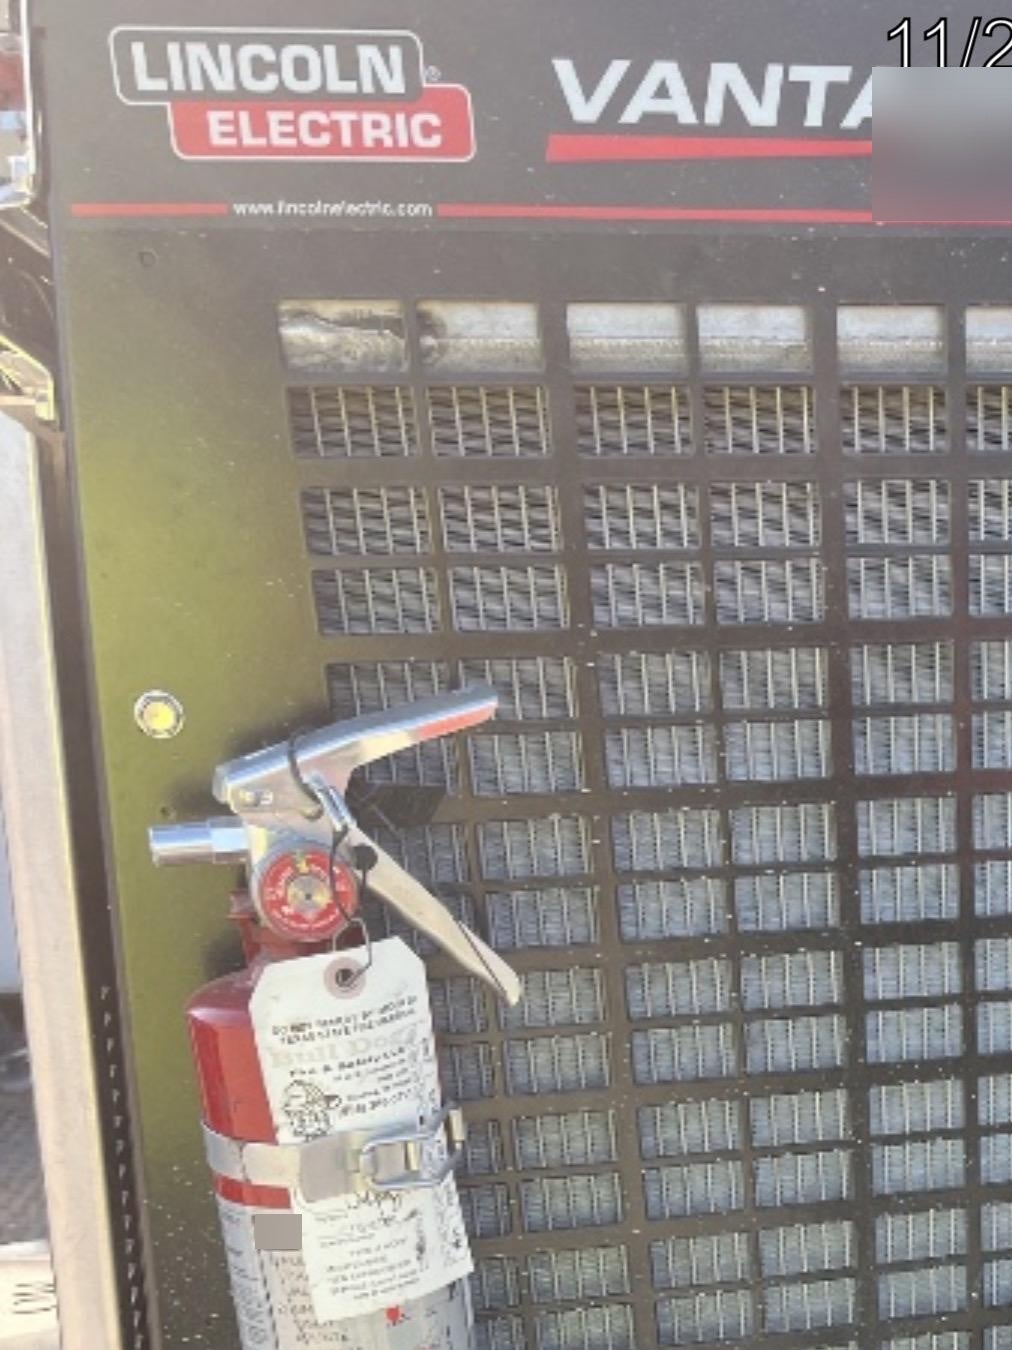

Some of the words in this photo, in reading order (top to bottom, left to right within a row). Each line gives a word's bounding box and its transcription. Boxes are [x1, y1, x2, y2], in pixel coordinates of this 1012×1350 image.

[130, 41, 406, 94] LINCOLN
[206, 110, 442, 148] ELECTRIC
[233, 200, 433, 216] www.lincolnelectric.com
